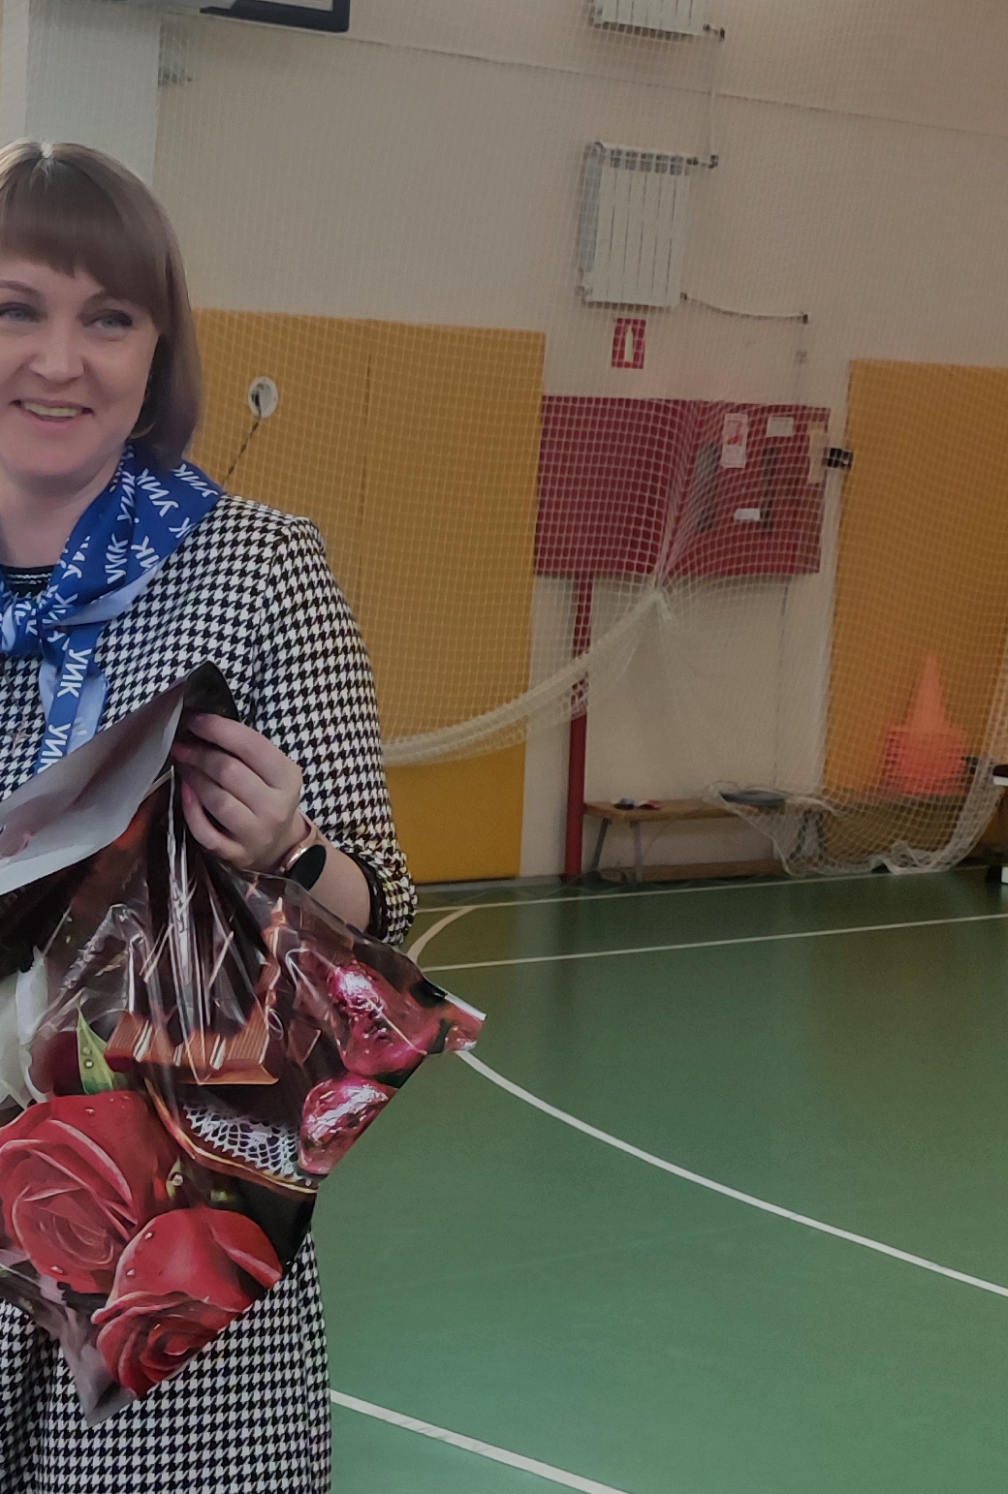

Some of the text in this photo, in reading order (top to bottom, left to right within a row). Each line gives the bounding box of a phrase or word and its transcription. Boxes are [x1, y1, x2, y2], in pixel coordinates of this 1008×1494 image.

[136, 468, 179, 518] УИК
[172, 463, 219, 498] УИК
[57, 648, 92, 698] УИК
